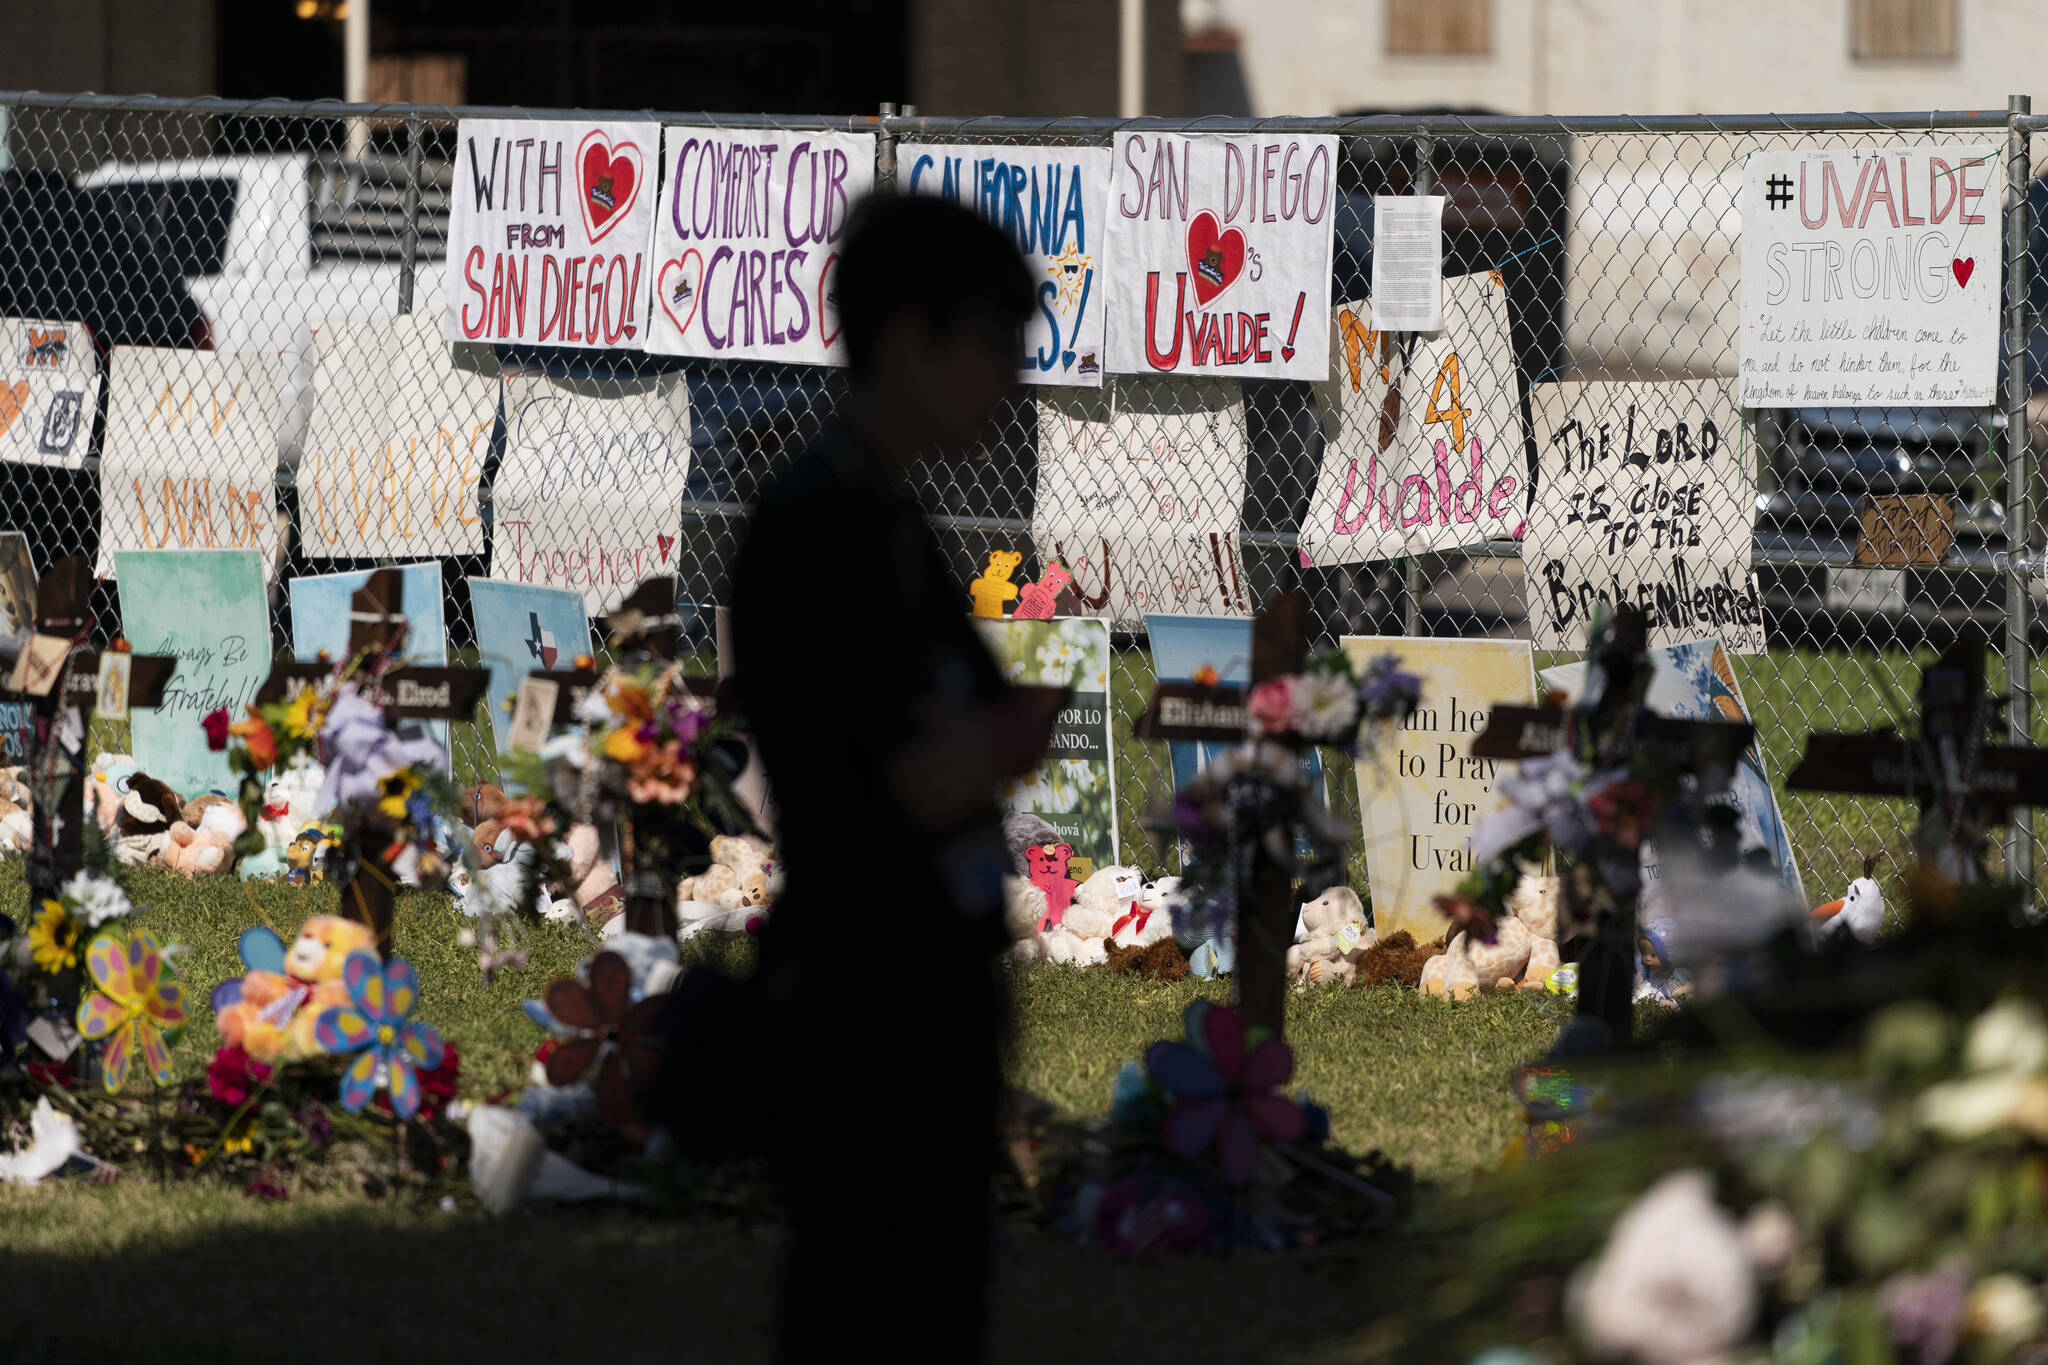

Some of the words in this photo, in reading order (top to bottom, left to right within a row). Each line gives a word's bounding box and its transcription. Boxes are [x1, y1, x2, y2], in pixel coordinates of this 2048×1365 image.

[468, 136, 563, 216] WITH
[672, 137, 779, 240] COMFORT
[783, 141, 849, 248] CUB
[1119, 134, 1190, 221] SAN
[1223, 141, 1330, 225] DIEGO
[1765, 157, 1986, 230] #UVALDE
[506, 222, 565, 250] FROM
[1766, 231, 1950, 305] STRONG
[461, 245, 529, 339] SAN
[538, 252, 642, 345] DIEGO!
[701, 245, 811, 350] CARES
[1788, 319, 1814, 342] the
[1819, 318, 1857, 341] little
[1862, 315, 1908, 342] children
[1914, 329, 1943, 343] come
[1949, 327, 1968, 344] to
[1762, 352, 1780, 372] and
[1788, 353, 1804, 373] do
[1811, 352, 1831, 372] not
[1839, 351, 1873, 373] hinder
[1909, 352, 1932, 380] for
[1937, 351, 1961, 372] the
[1426, 352, 1472, 453] 4
[1742, 377, 1784, 405] kingdom
[1785, 383, 1799, 403] of
[1803, 384, 1829, 401] heaven
[1832, 384, 1862, 405] belongs
[1866, 383, 1884, 401] to
[1887, 382, 1911, 401] such
[1914, 389, 1923, 401] as
[316, 421, 493, 545] UVALDE
[1333, 435, 1516, 536] Uvalde
[1567, 483, 1611, 526] IS
[499, 521, 653, 588] Together
[1603, 520, 1640, 556] TO
[156, 636, 215, 677] Always
[220, 635, 249, 667] Be
[153, 674, 259, 722] Grateful!
[1057, 709, 1083, 725] POR
[1084, 709, 1102, 725] LO
[1397, 749, 1426, 778] to
[1435, 743, 1502, 793] Pray
[1433, 788, 1477, 826] for
[1409, 834, 1478, 872] Uval
